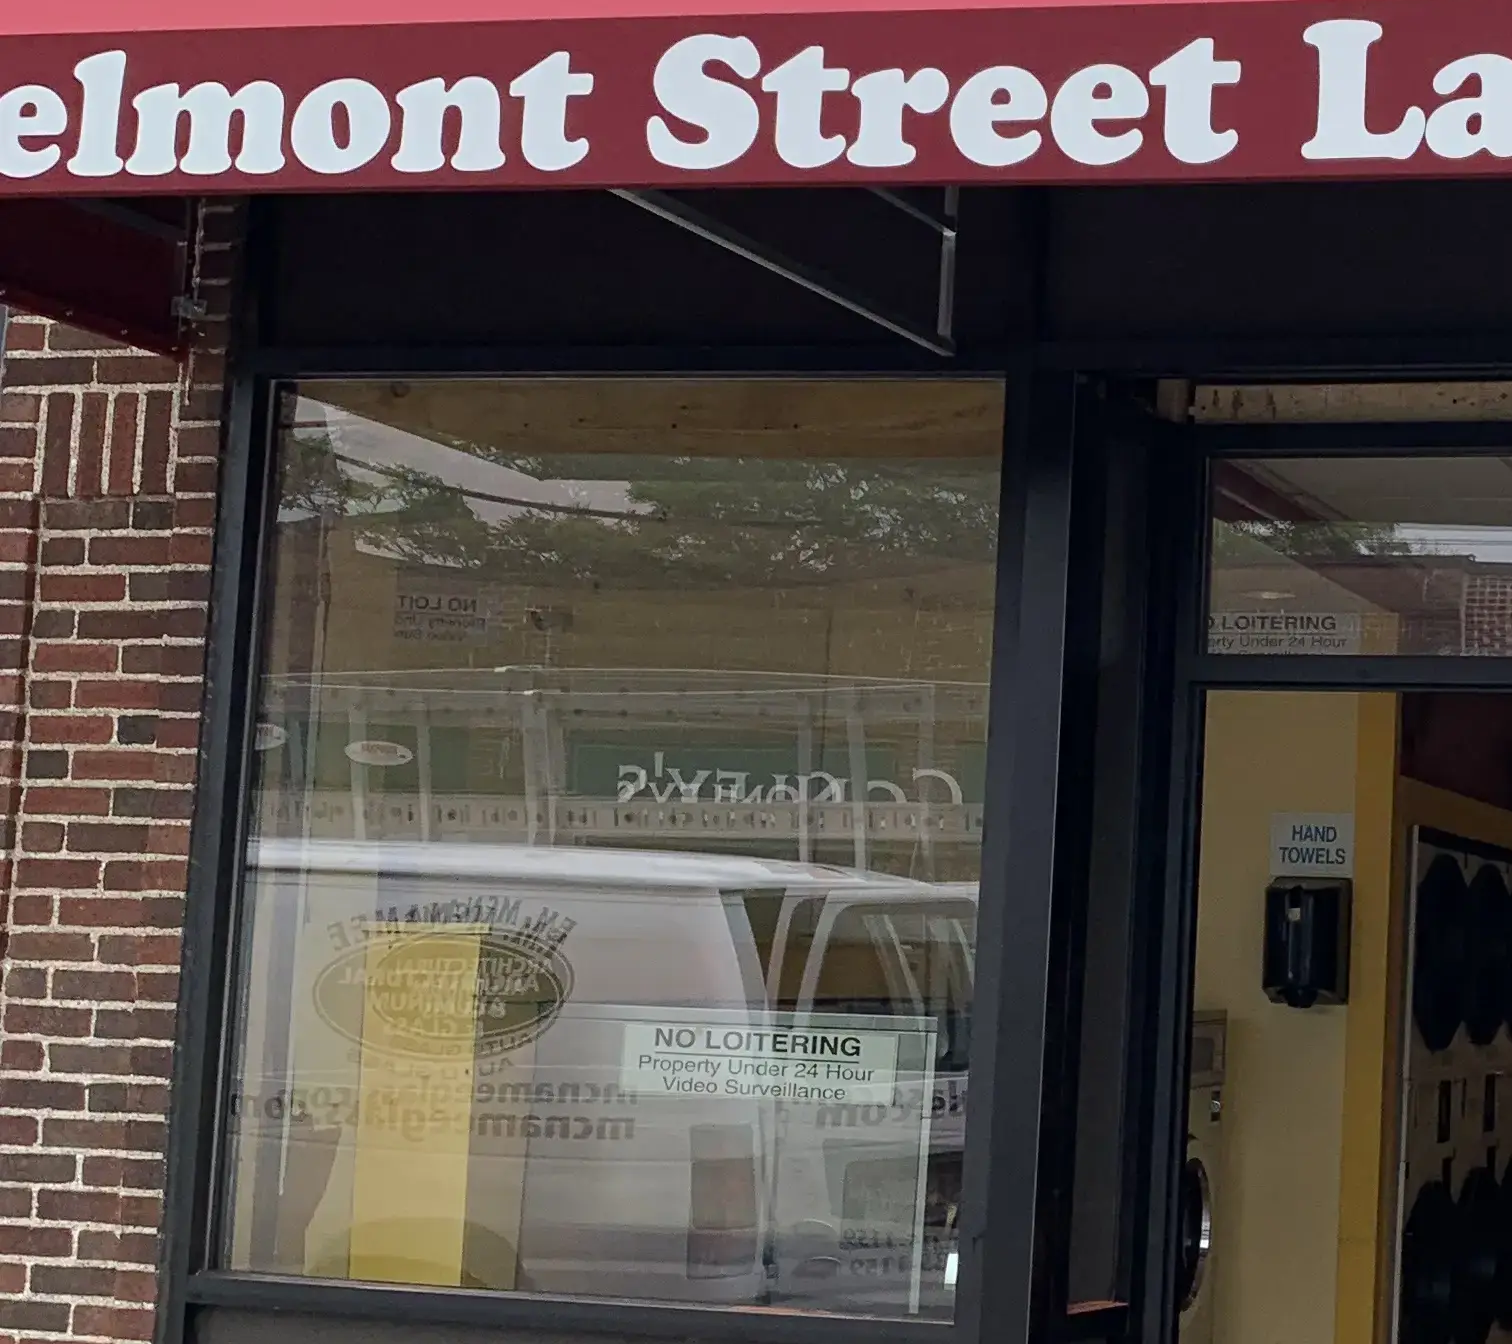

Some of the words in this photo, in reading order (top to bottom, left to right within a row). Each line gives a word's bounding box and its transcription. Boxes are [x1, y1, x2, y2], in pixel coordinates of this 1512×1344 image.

[646, 32, 1242, 170] Street
[1221, 615, 1338, 631] LOITERING
[1239, 635, 1285, 648] Under
[1311, 637, 1348, 648] Hour
[1291, 824, 1337, 843] HAND
[1278, 846, 1347, 865] TOWELS
[653, 1027, 696, 1049] NO
[705, 1029, 861, 1057] LOITERING
[638, 1055, 721, 1076] Property
[728, 1059, 789, 1078] Under
[794, 1063, 819, 1079] 24
[826, 1064, 875, 1083] Hour
[662, 1075, 718, 1094] Video
[724, 1078, 846, 1101] Surveillance
